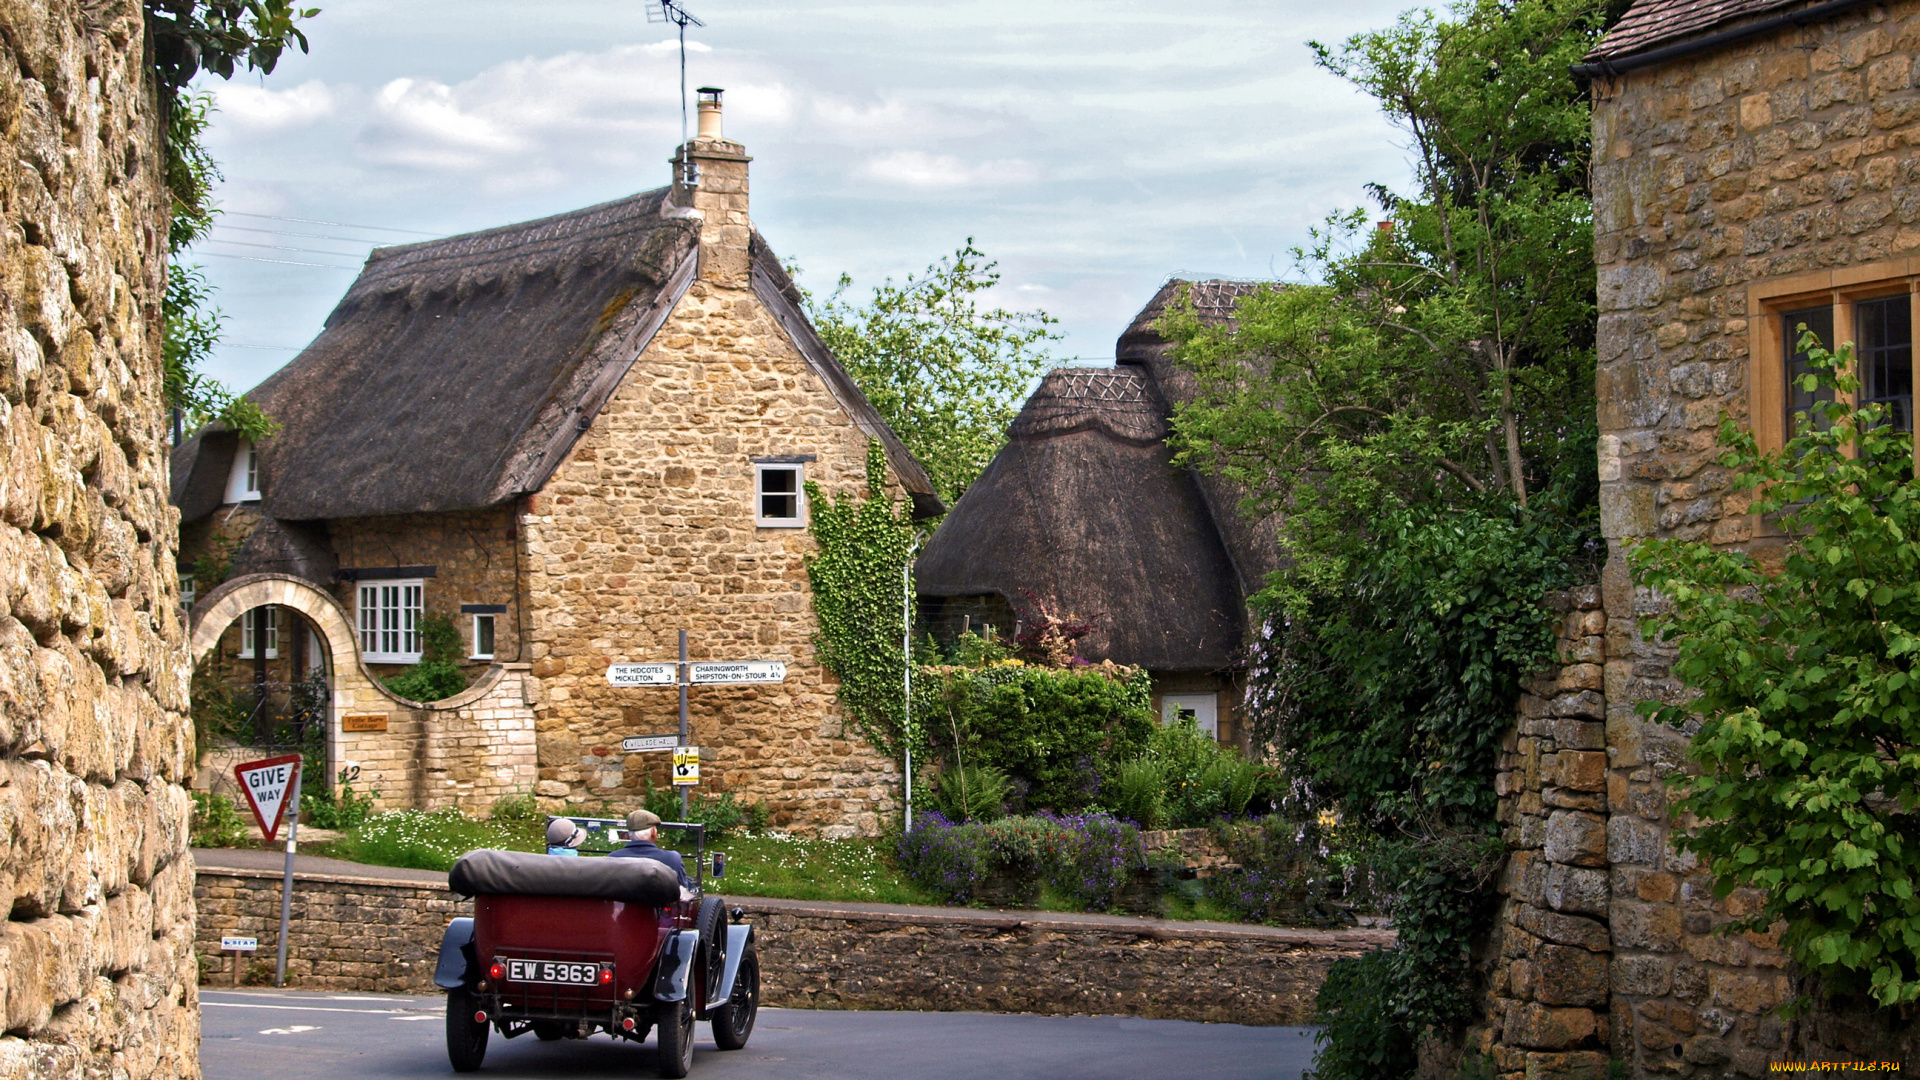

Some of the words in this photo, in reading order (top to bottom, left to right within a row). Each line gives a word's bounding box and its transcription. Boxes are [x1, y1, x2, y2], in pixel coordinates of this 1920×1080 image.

[249, 767, 285, 788] GIVE
[257, 788, 281, 803] WAY
[510, 962, 537, 979] EW
[543, 963, 595, 983] 5363
